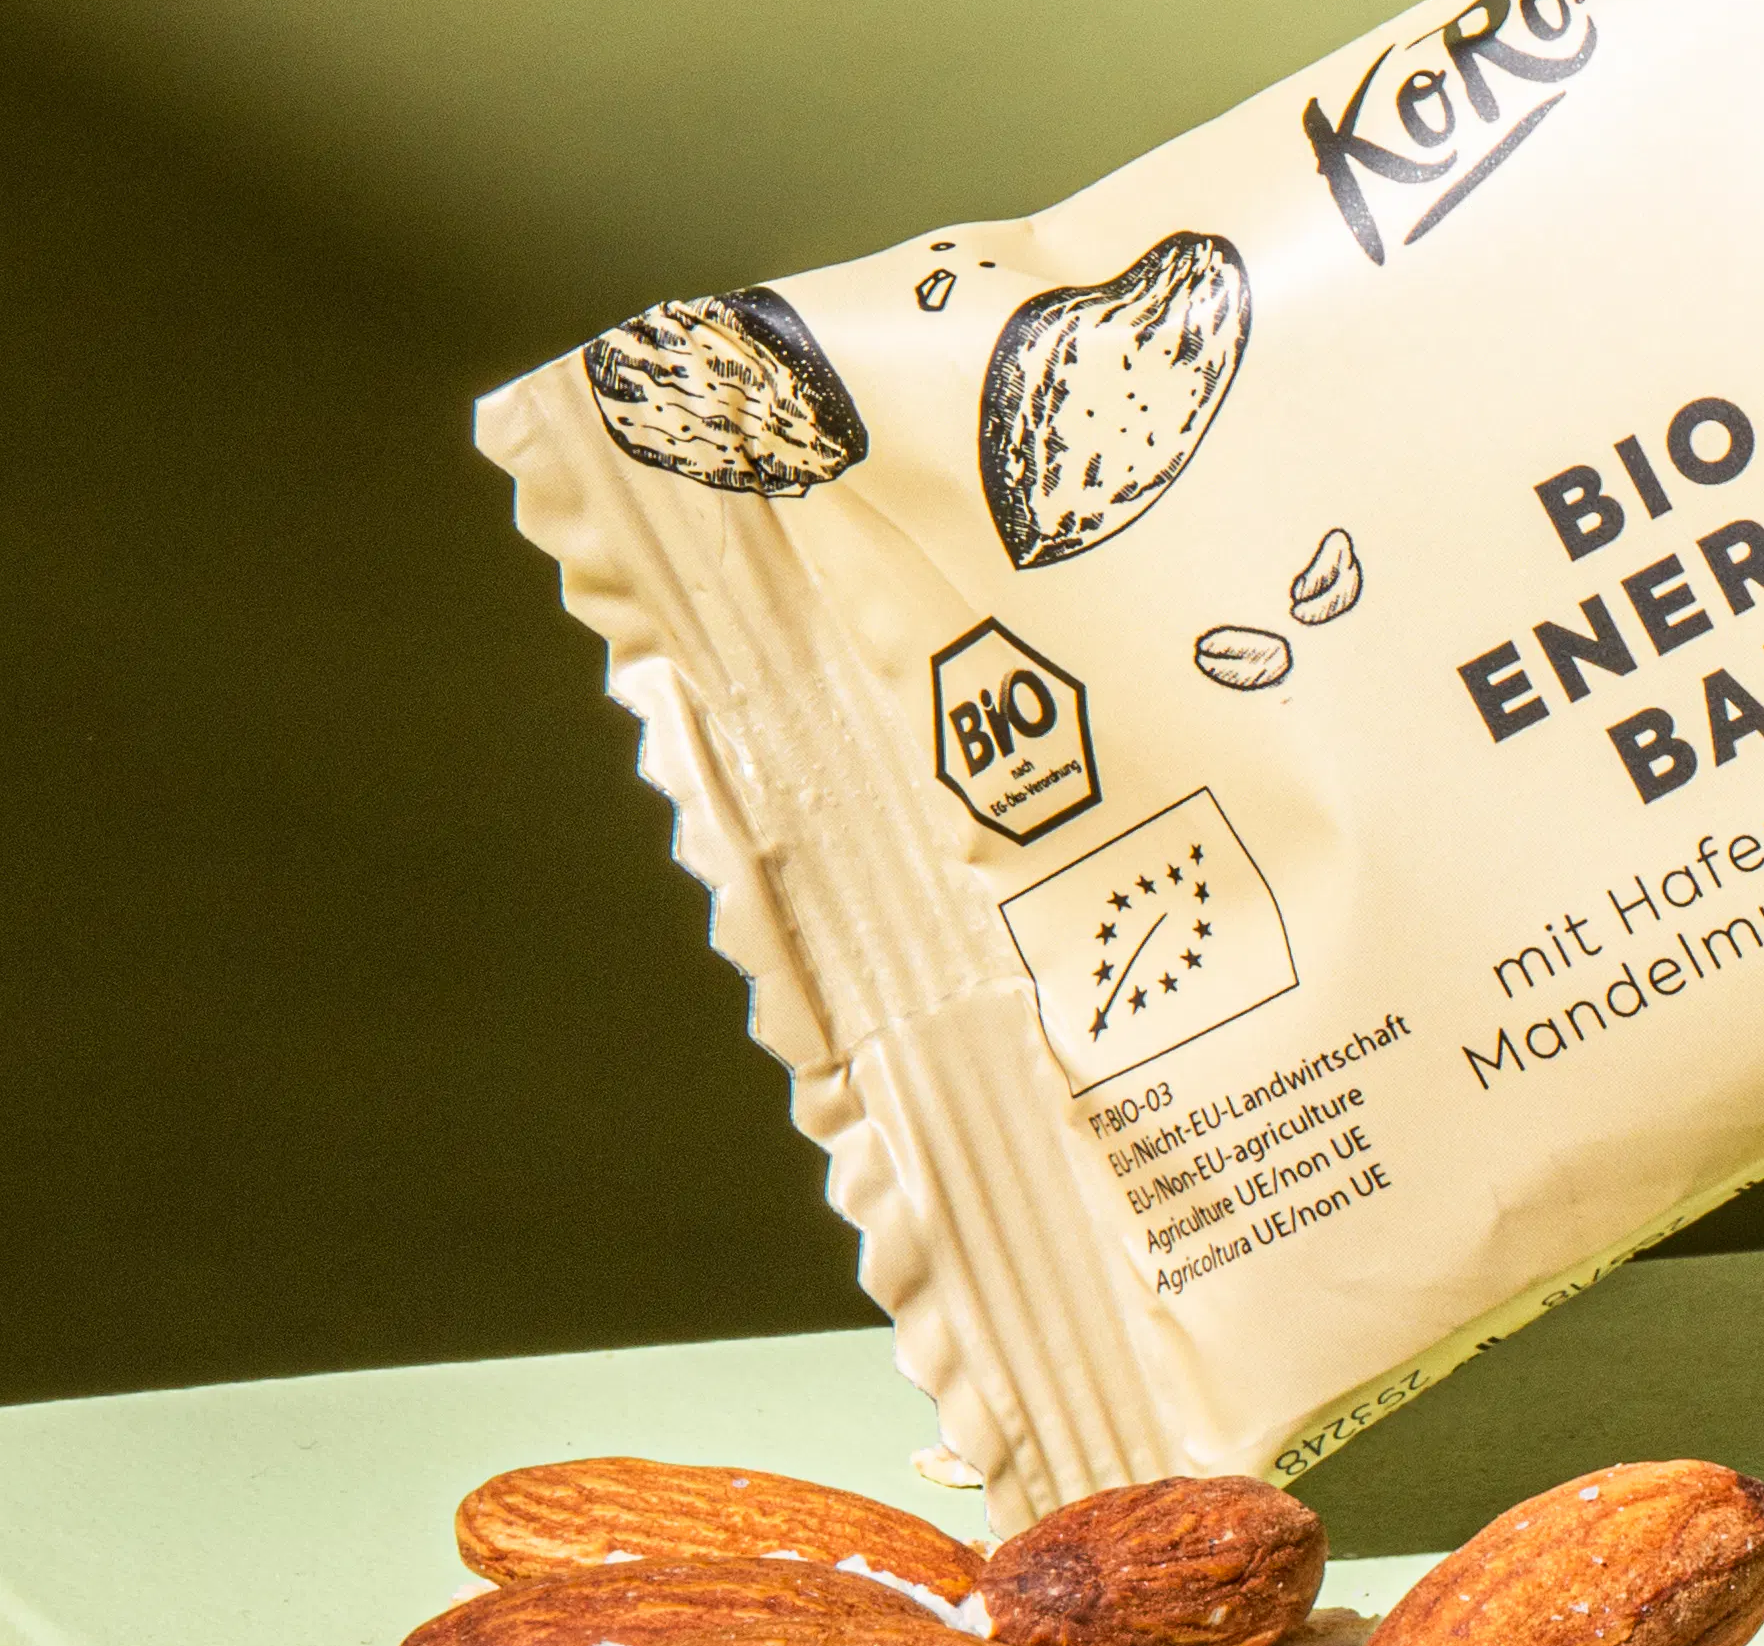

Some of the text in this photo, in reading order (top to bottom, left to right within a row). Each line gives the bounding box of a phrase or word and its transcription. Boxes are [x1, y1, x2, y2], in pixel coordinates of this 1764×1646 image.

[1534, 398, 1754, 562] BIO
[1494, 917, 1602, 998] mit
[1088, 1083, 1173, 1139] PT-BIO-03
[1108, 1014, 1411, 1177] EU-/Nicht-EU-Landwirtschaft
[1127, 1089, 1364, 1214] EU-/Non-EU-agriculture
[1147, 1126, 1371, 1254] Agriculture UE/non UE
[1157, 1164, 1391, 1294] Agricoltura UE/non UE
